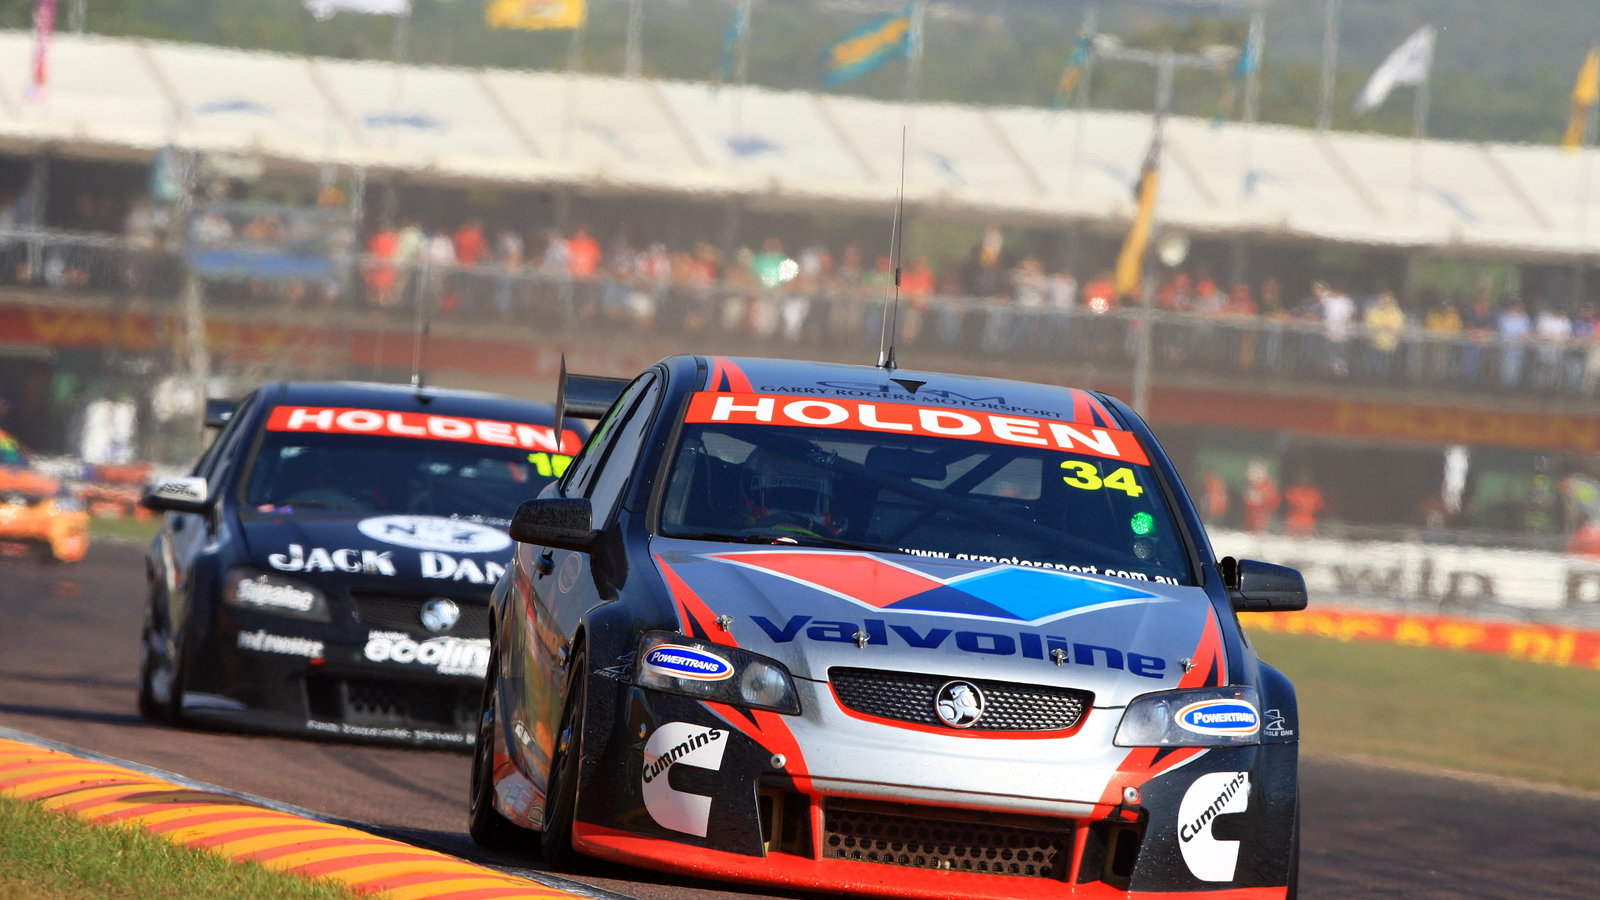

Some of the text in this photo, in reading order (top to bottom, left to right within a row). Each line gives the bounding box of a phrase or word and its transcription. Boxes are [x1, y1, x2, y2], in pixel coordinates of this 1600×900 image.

[761, 385, 1063, 419] GARRY ROGERS MOTORSPORT
[287, 409, 566, 452] HOLDEN
[711, 396, 1121, 457] HOLDEN
[1060, 460, 1144, 498] 34
[269, 543, 398, 577] JACK
[419, 551, 508, 585] DAN
[651, 651, 720, 672] POWERTRANS
[748, 615, 1167, 679] Valvoline
[1193, 711, 1255, 725] POWERTRANS
[1280, 729, 1293, 737] ONE
[643, 728, 721, 784] Cummins
[1180, 771, 1245, 843] Cummins
